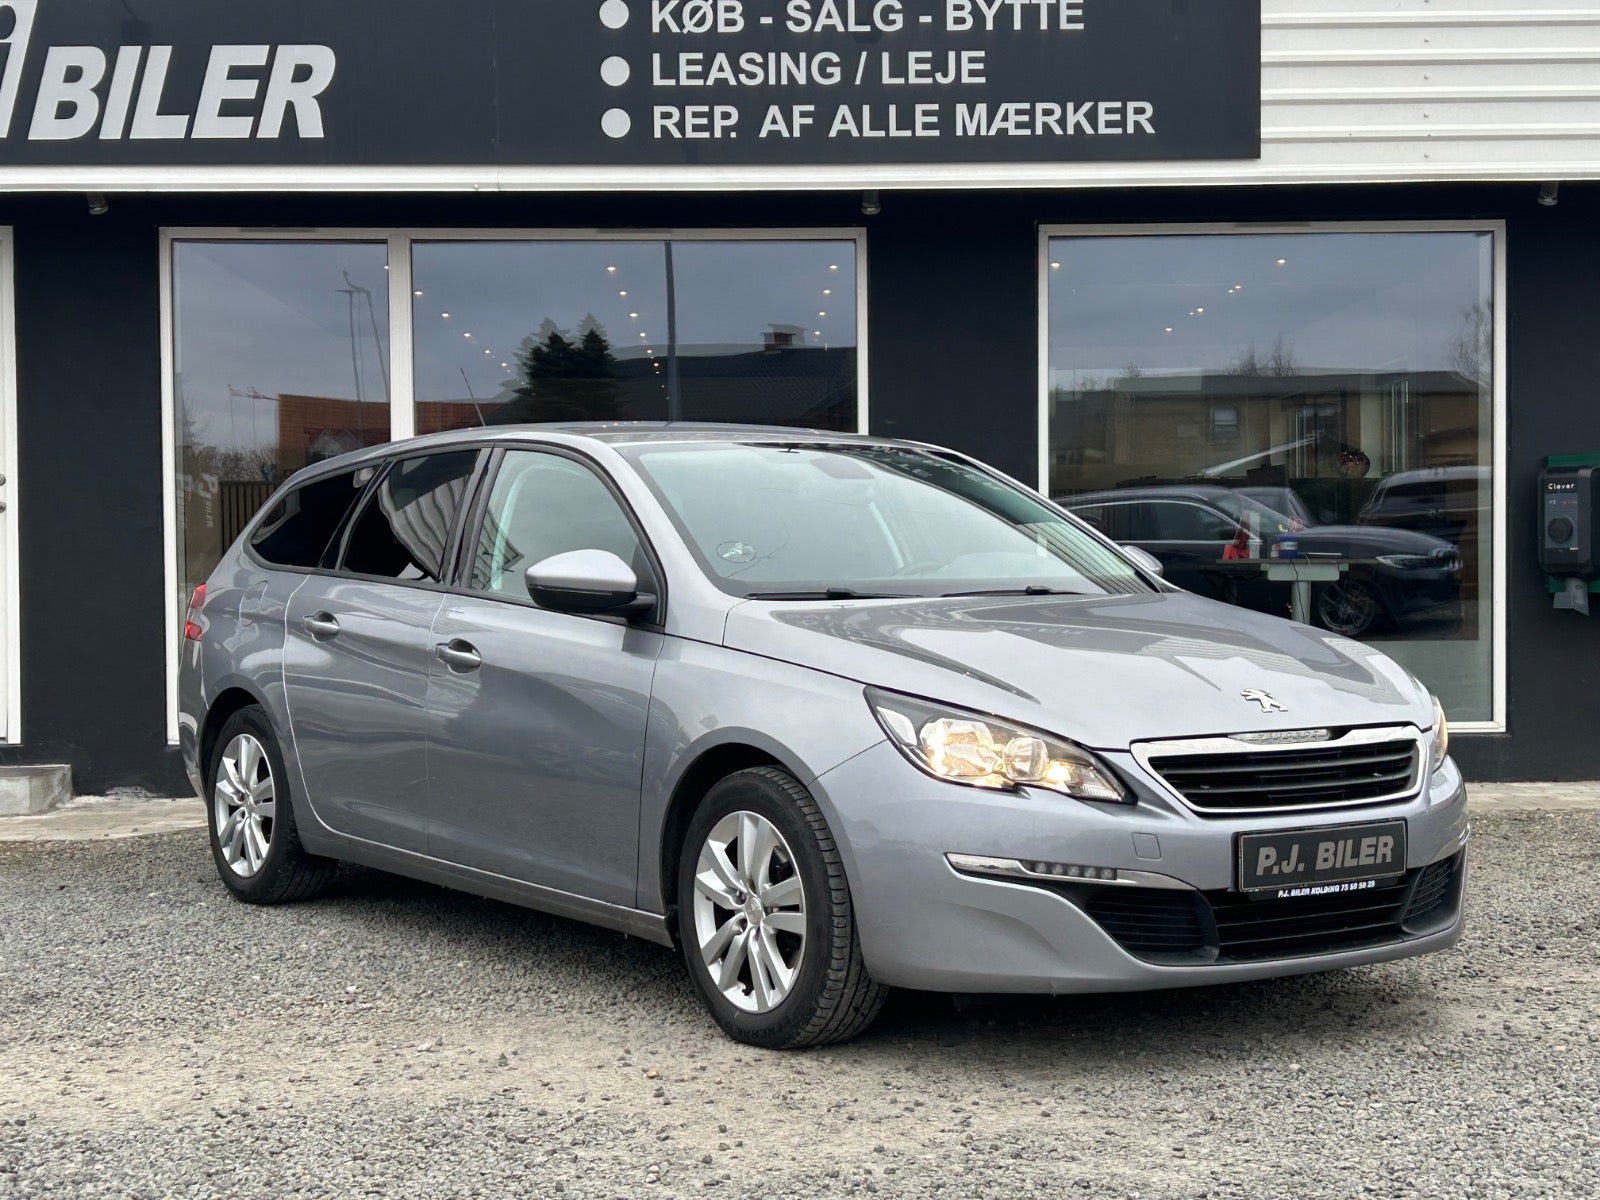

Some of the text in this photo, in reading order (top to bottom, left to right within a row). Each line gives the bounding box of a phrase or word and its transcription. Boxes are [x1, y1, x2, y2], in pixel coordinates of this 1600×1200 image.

[651, 0, 745, 34] KØB
[785, 0, 904, 33] SALG
[946, 0, 1085, 31] BYTTE
[652, 50, 986, 86] LEASING / LEJE
[27, 44, 336, 141] BILER
[653, 101, 1156, 139] REP. AF ALLE MÆRKER
[1547, 482, 1575, 490] Clever
[1256, 835, 1394, 876] P.J. BILER
[1290, 887, 1310, 897] BILER
[1311, 884, 1340, 895] KOLDING
